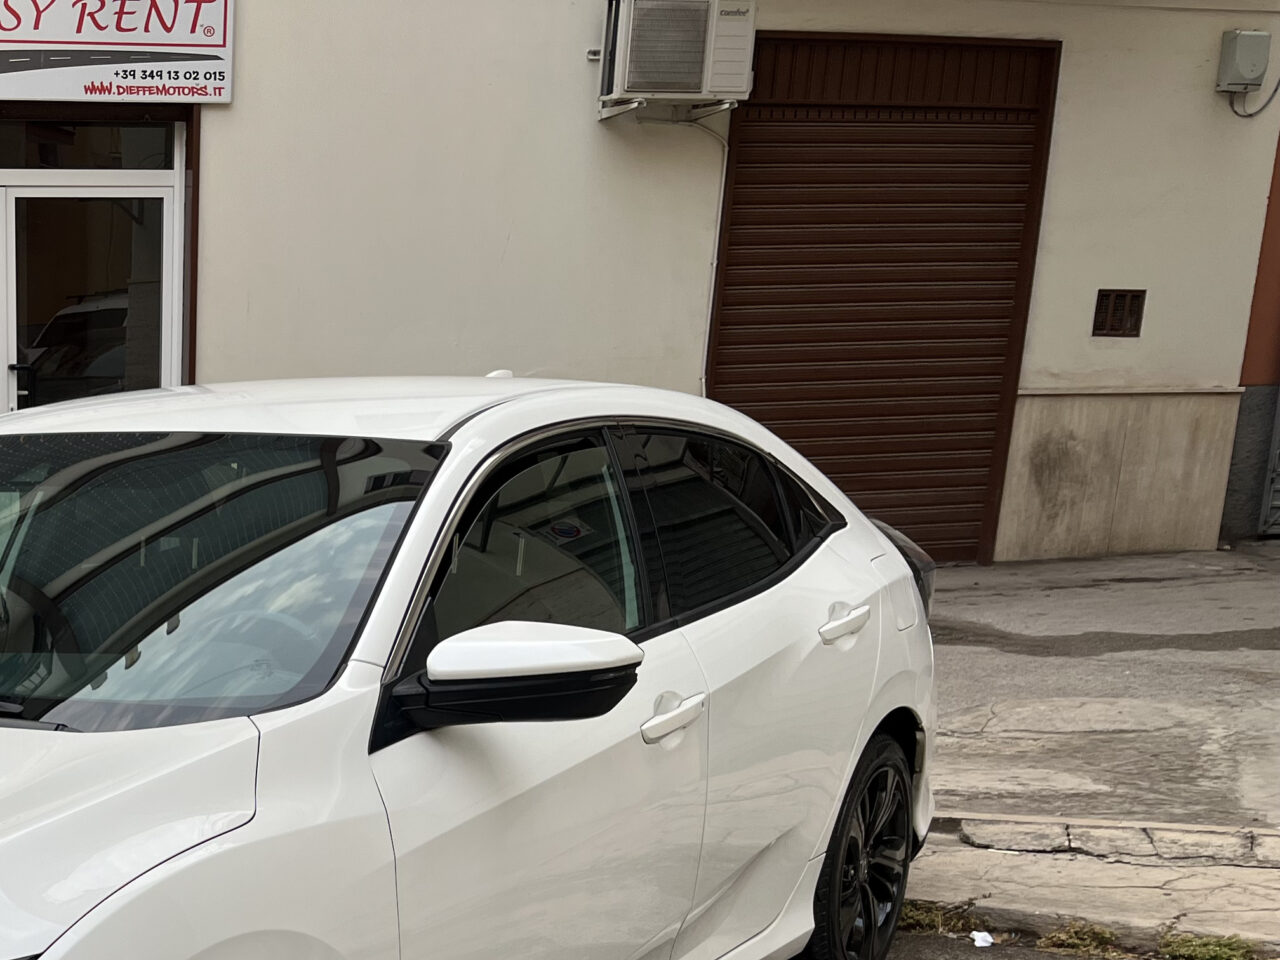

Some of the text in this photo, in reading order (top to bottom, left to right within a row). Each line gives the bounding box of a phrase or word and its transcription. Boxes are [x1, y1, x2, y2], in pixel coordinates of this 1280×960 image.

[72, 0, 216, 34] RENT
[114, 69, 226, 82] +39 349 13 02 015
